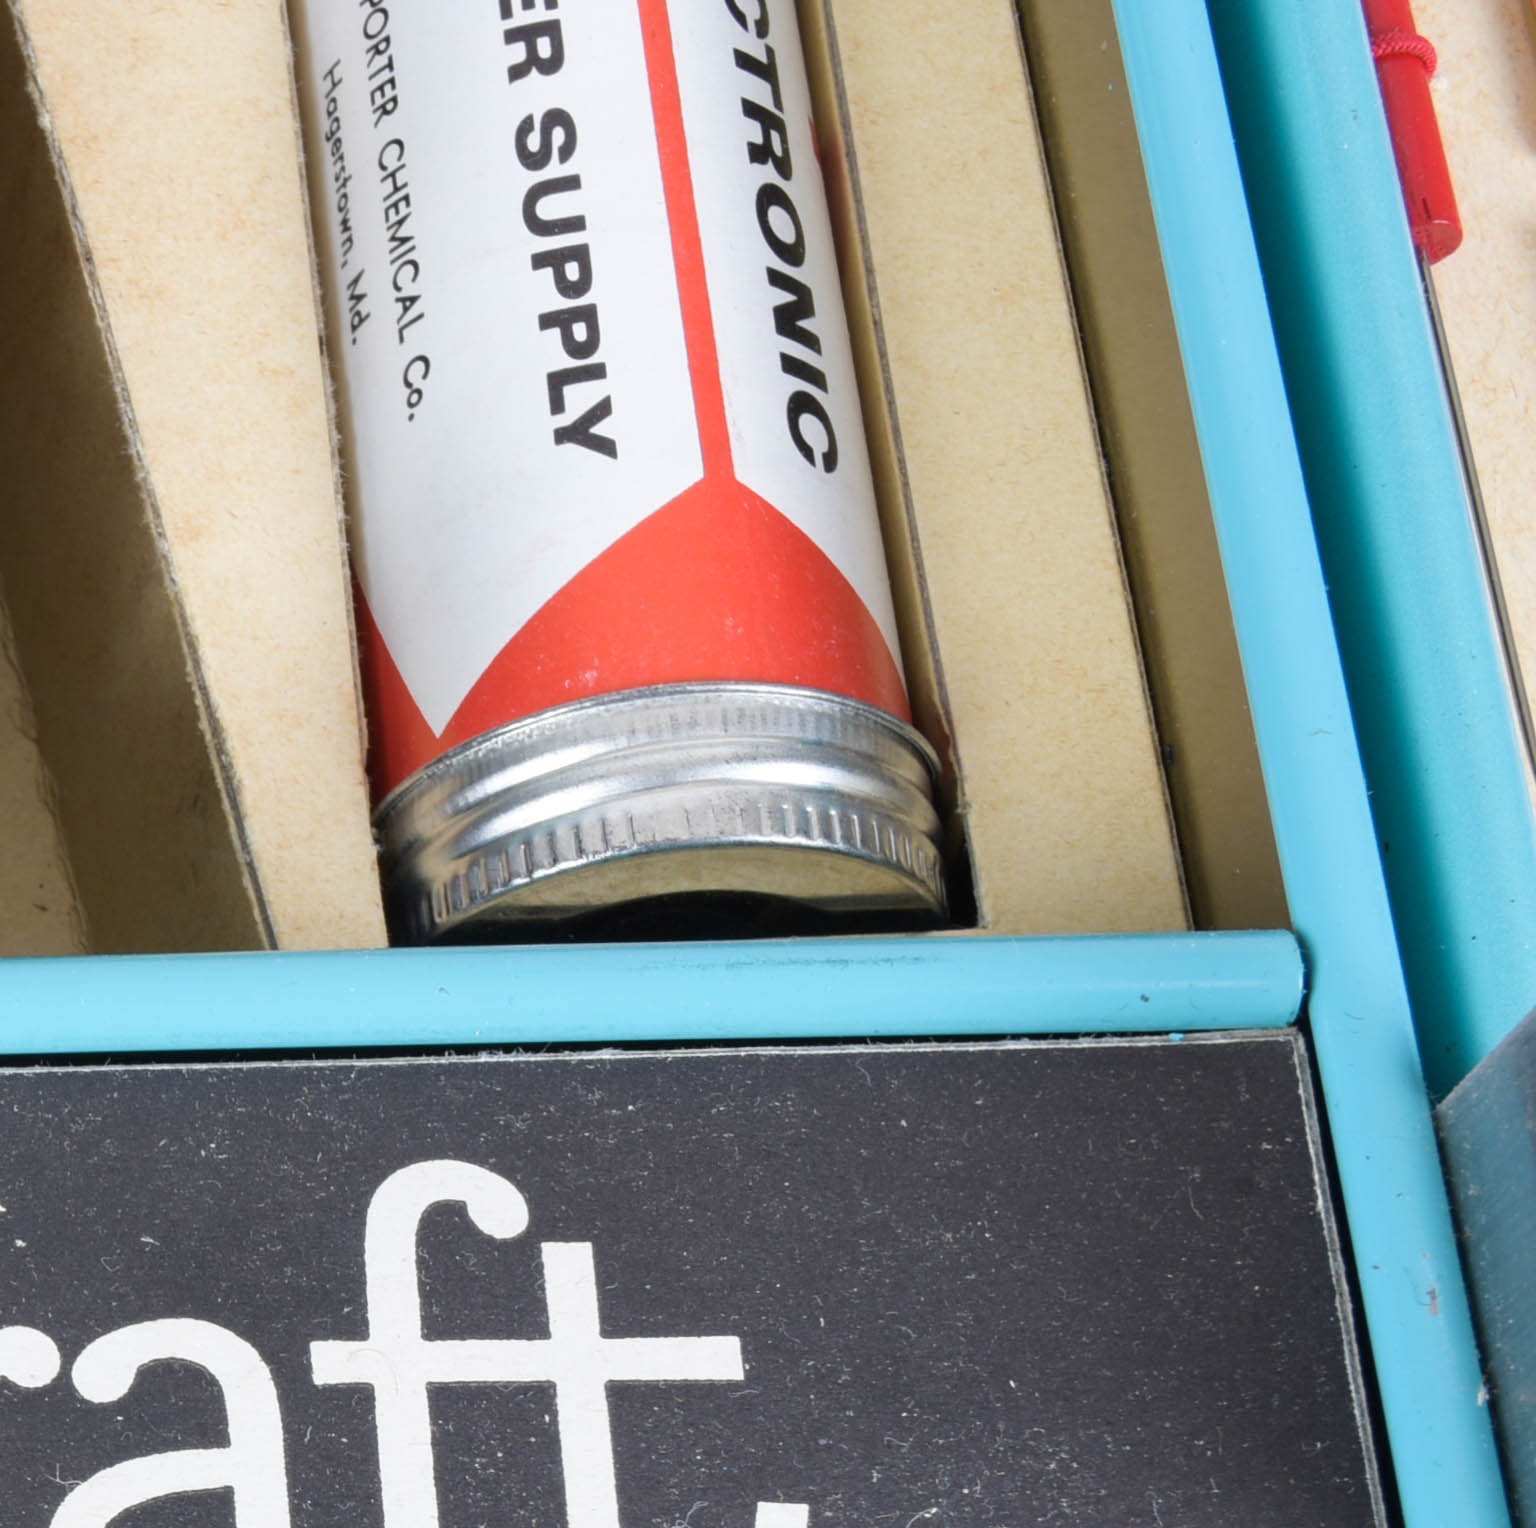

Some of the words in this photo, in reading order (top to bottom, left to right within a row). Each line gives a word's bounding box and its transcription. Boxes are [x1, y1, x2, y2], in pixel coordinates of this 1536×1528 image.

[322, 59, 355, 270] Hagerstown,
[346, 269, 371, 346] Md.
[377, 138, 425, 345] CHEMICAL
[402, 354, 431, 422] Co.
[515, 107, 618, 460] SUPPLY
